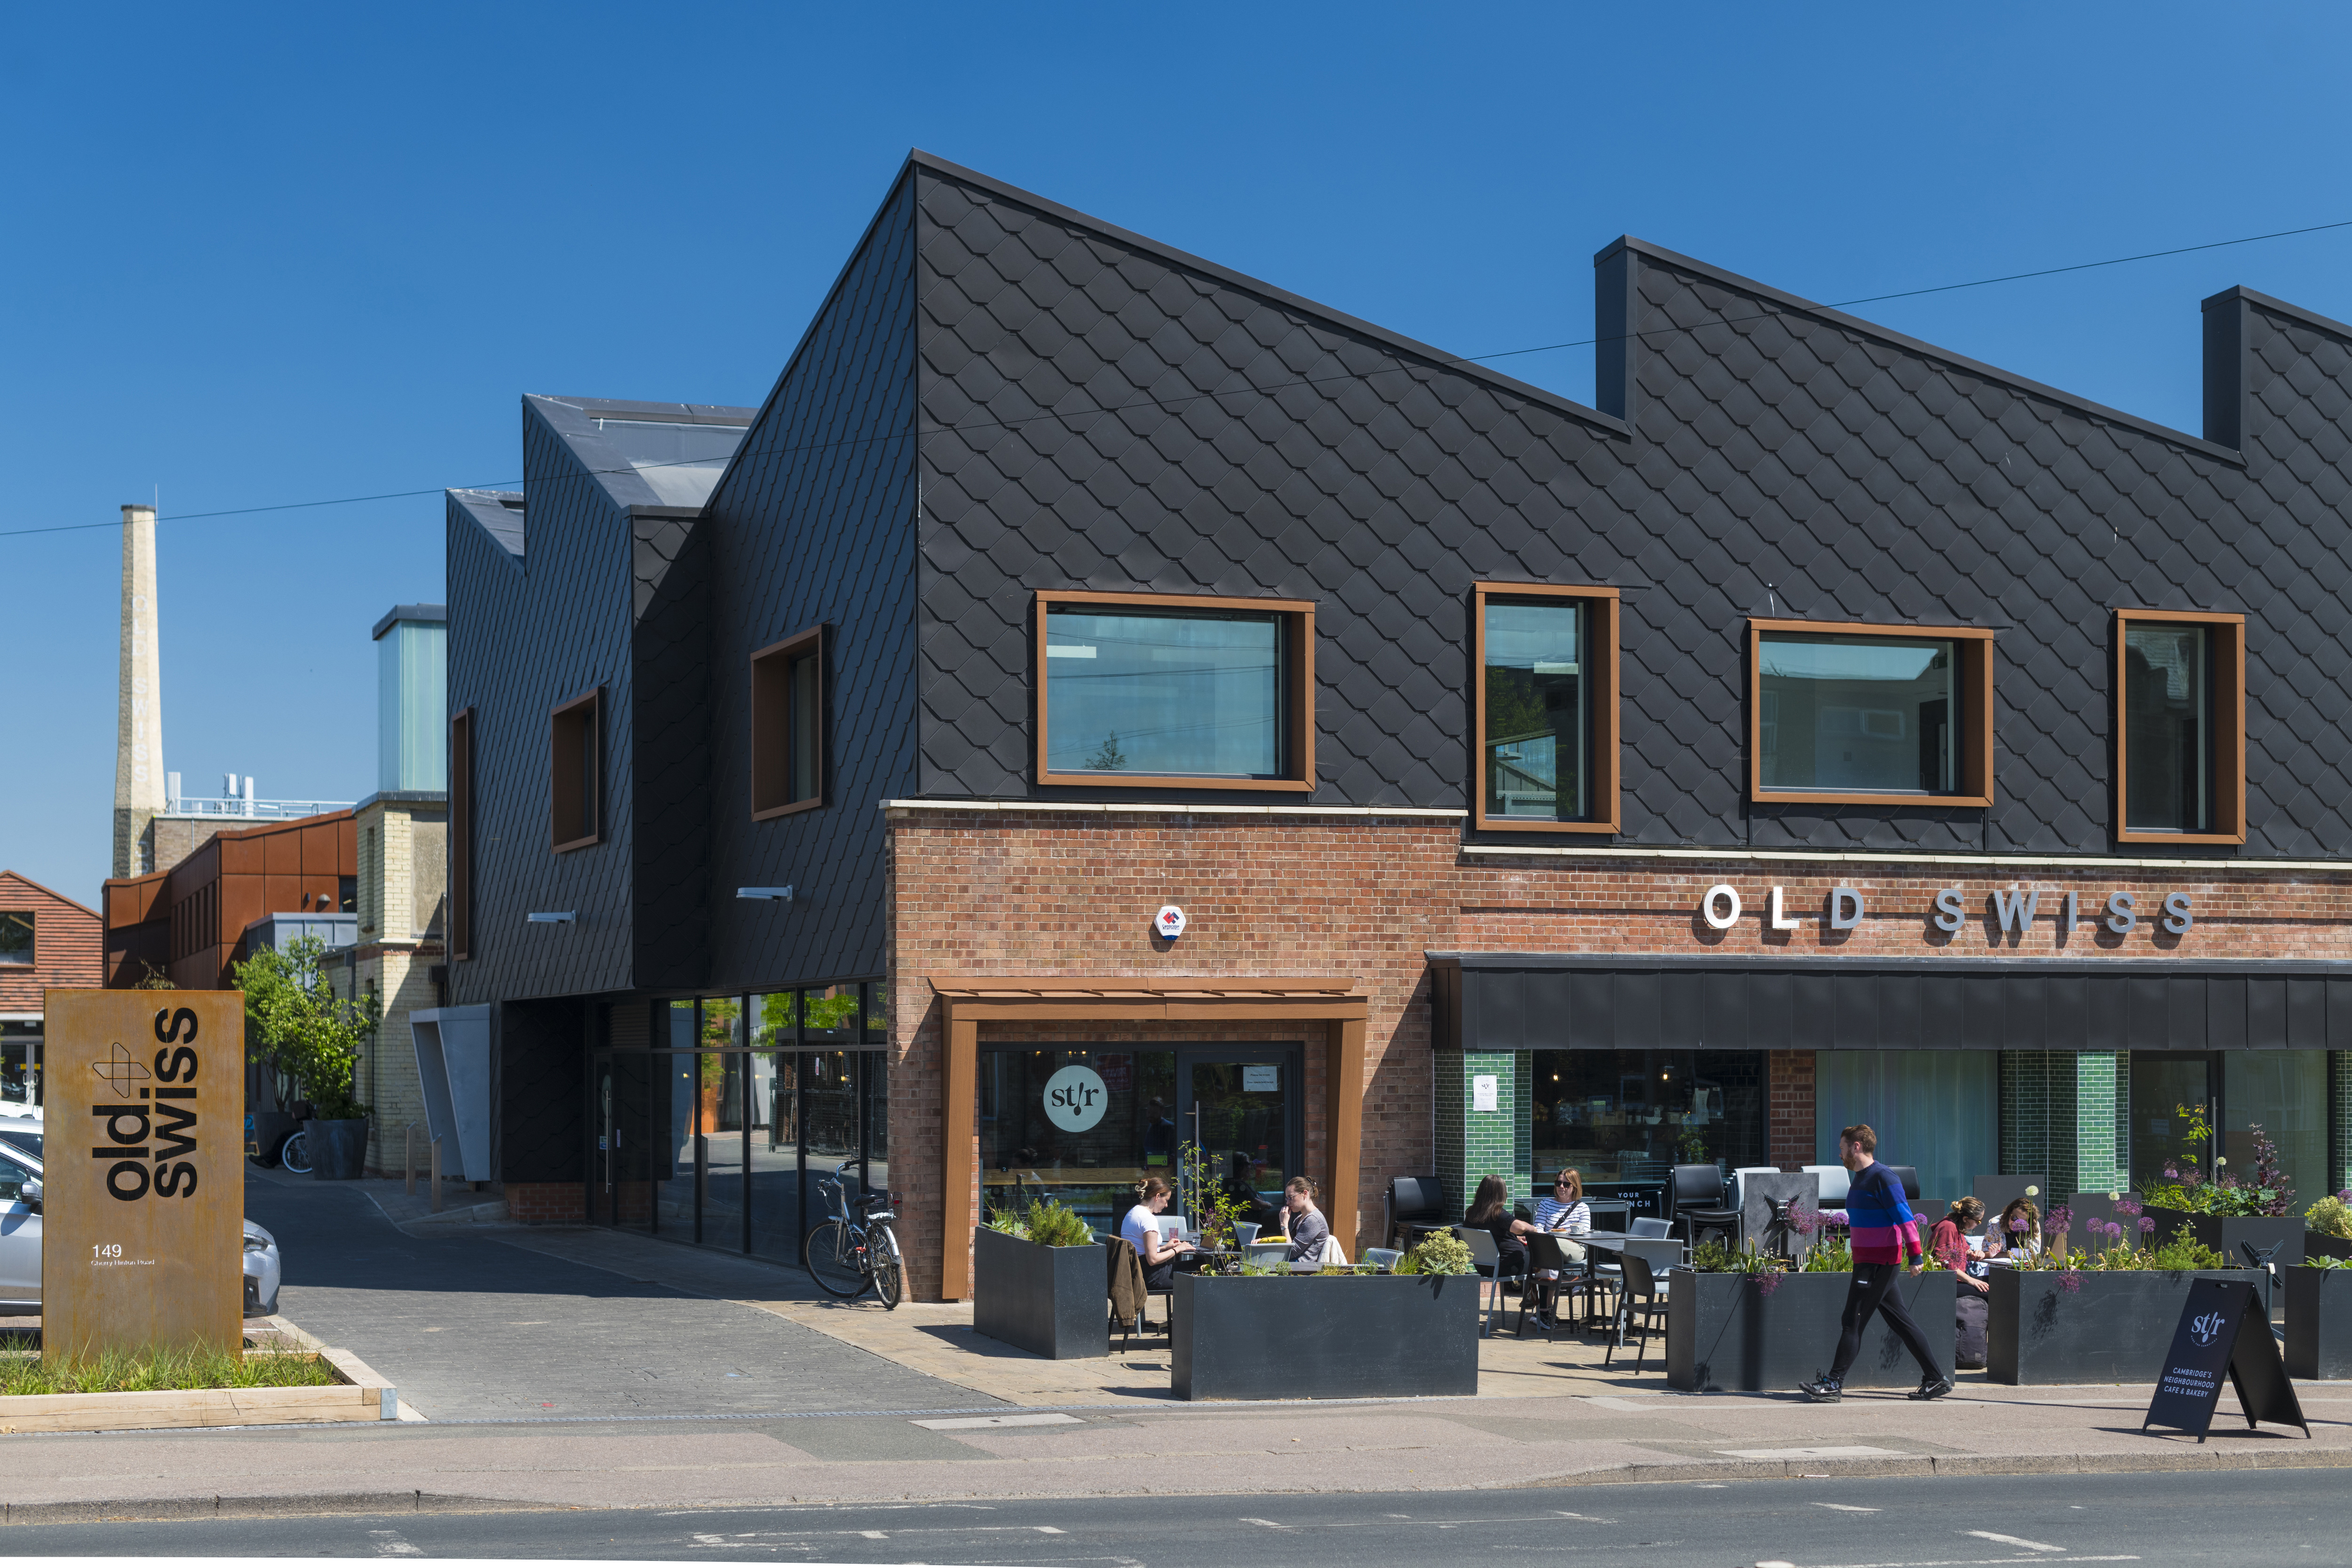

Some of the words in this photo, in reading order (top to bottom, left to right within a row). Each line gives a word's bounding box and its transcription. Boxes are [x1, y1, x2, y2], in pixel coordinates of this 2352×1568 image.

[132, 595, 148, 656] OLD
[132, 677, 148, 782] SWISS
[1702, 884, 1864, 929] OLD
[1935, 889, 2193, 934] SWISS
[141, 1007, 198, 1198] swiss
[92, 1105, 150, 1201] old
[92, 1244, 121, 1258] 149
[2164, 1376, 2215, 1388] NEIGHBOURHOOD
[2173, 1367, 2212, 1378] CAMBRIDGE'S
[2186, 1388, 2209, 1398] BAKERY
